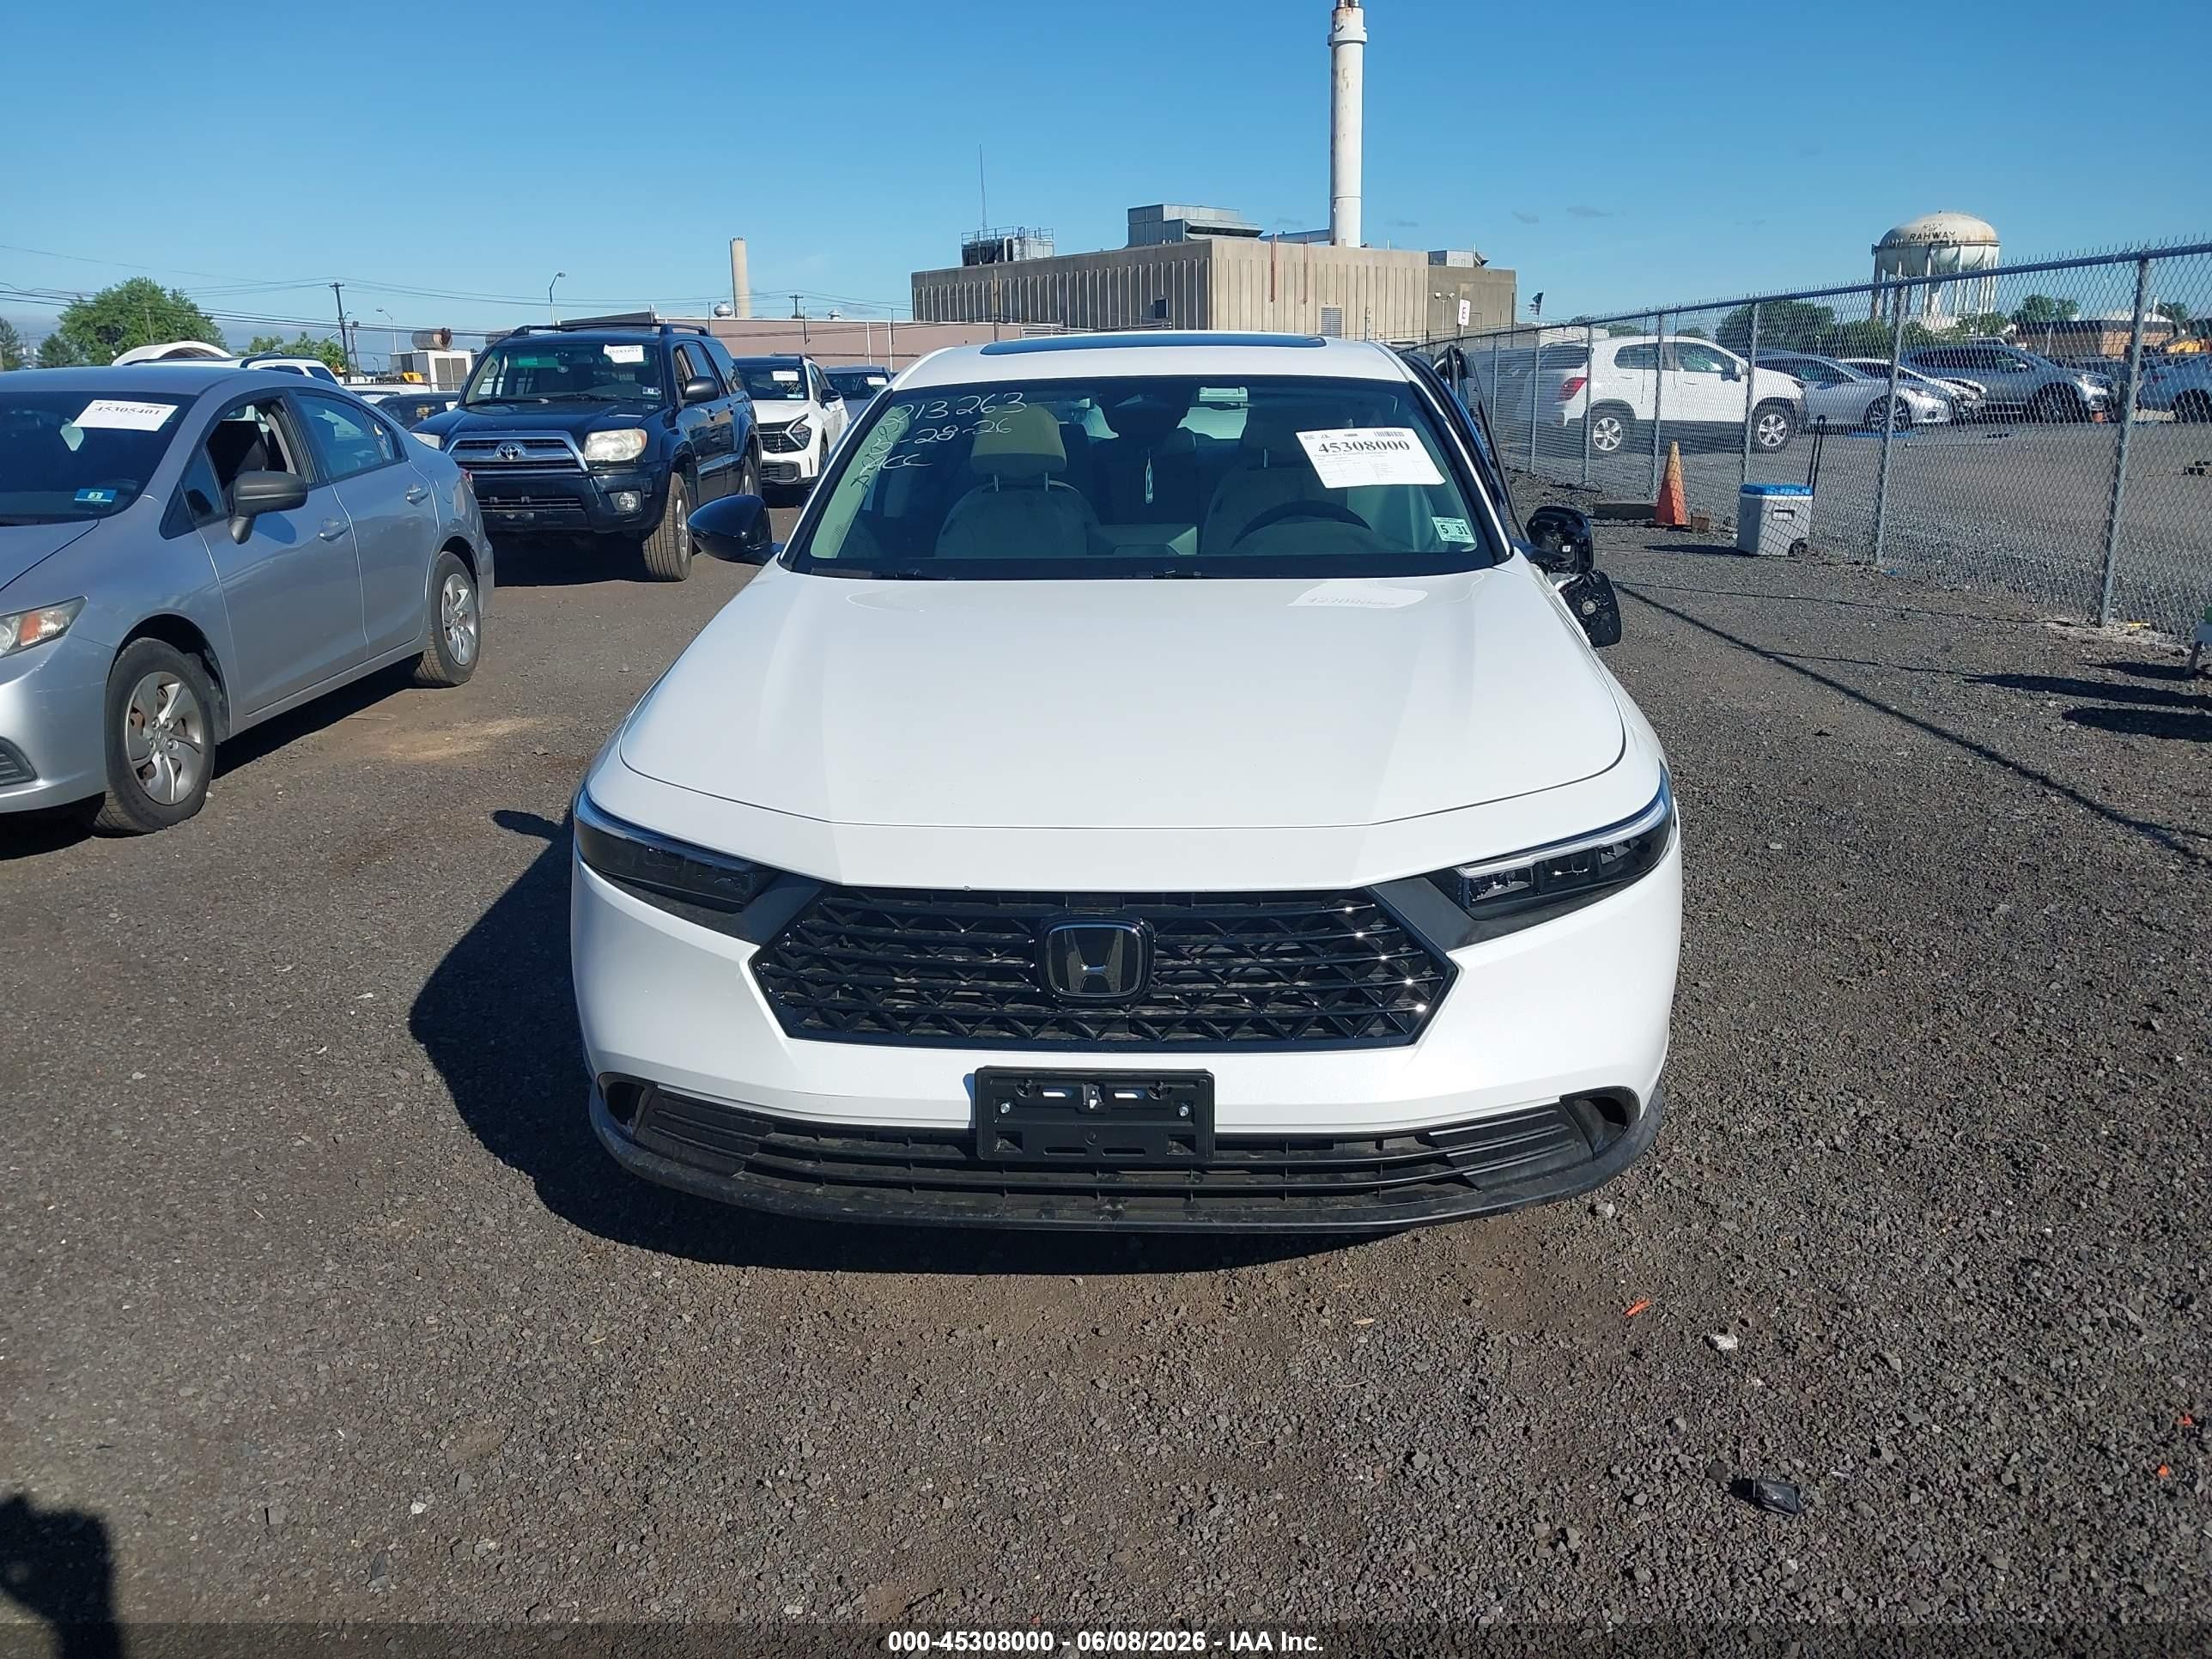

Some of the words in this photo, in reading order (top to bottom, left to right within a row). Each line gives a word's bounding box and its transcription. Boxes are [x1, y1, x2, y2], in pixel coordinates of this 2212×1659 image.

[1909, 231, 1956, 241] RAHWAY
[1318, 440, 1411, 453] 45308000
[1439, 524, 1449, 534] 5
[1455, 525, 1469, 535] 31
